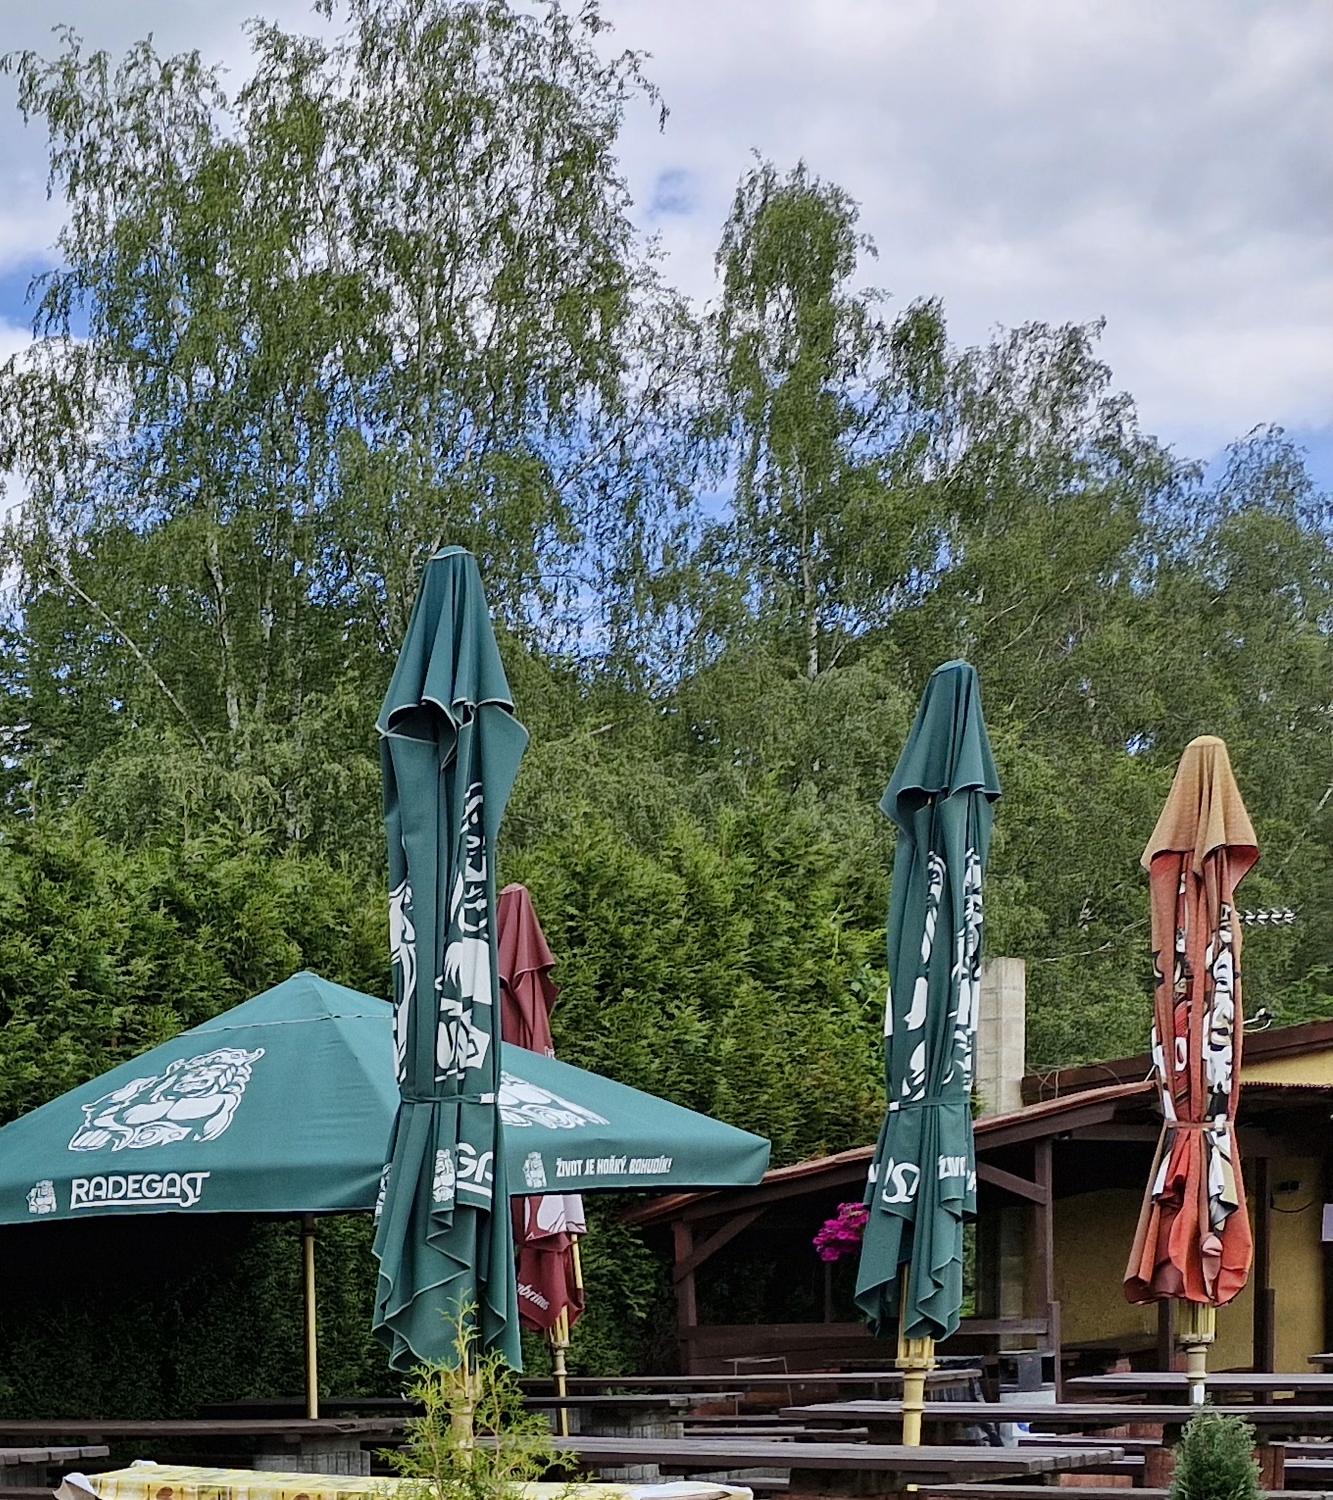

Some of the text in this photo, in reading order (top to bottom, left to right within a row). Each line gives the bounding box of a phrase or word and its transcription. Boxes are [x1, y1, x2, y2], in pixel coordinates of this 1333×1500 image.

[556, 1157, 583, 1177] ŽIVOT
[584, 1158, 596, 1175] JE
[70, 1171, 211, 1210] RADEGAST
